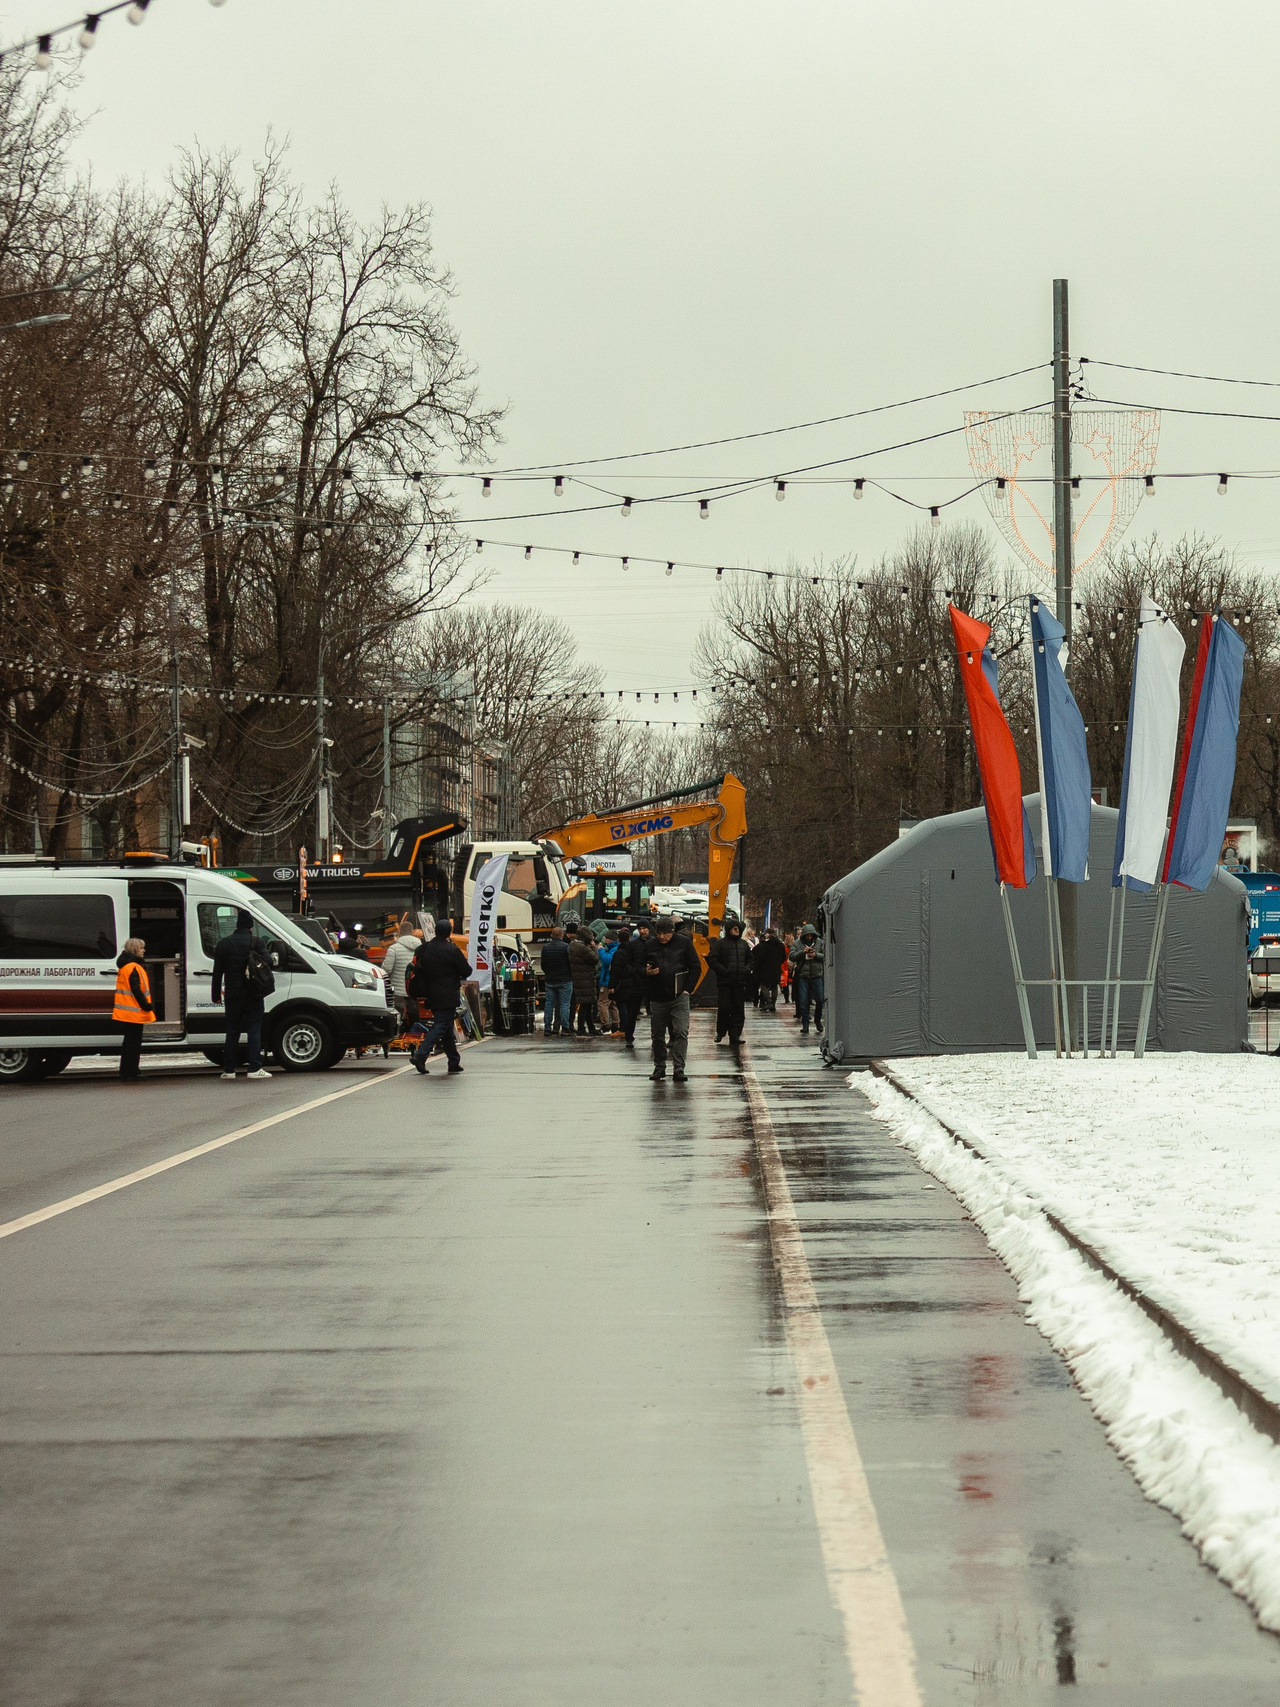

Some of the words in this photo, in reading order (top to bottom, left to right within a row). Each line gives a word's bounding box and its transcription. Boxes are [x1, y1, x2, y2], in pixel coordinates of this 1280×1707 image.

[627, 815, 674, 837] XCMG
[320, 867, 361, 878] TRUCKS
[0, 967, 41, 977] ДОРОЖНАЯ
[43, 967, 96, 977] ЛАБОРАТОРИЯ
